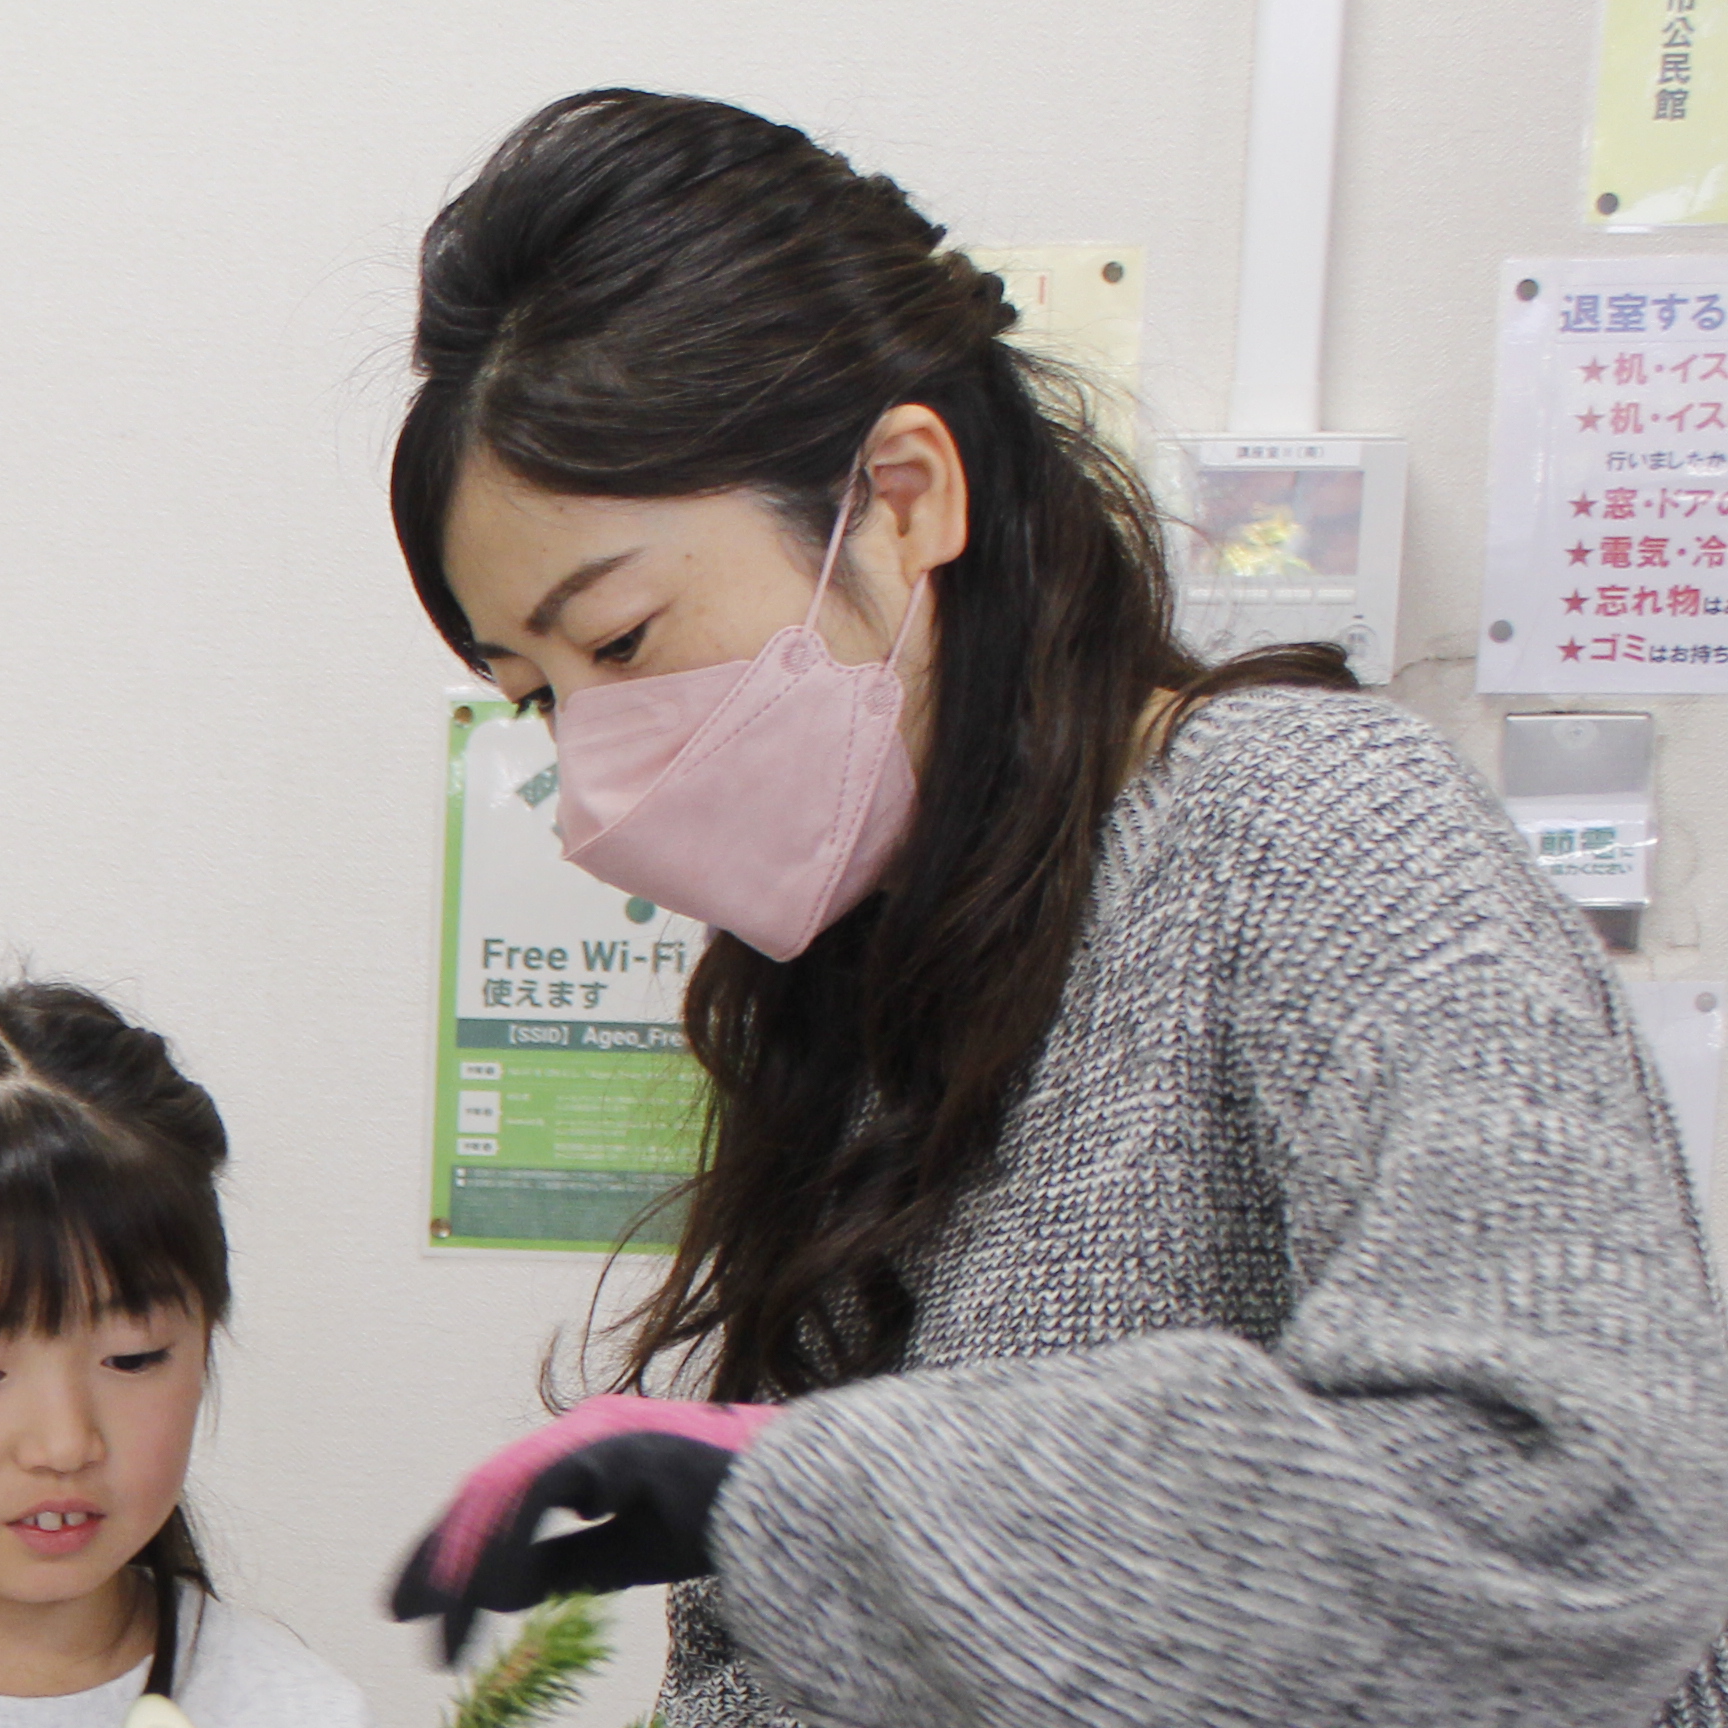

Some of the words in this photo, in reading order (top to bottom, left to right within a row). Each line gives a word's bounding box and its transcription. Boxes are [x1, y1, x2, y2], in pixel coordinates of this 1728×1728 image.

[1560, 293, 1726, 332] 退室する
[1595, 585, 1728, 617] 忘れ物は
[482, 938, 568, 971] Free
[582, 940, 686, 973] Wi-Fi
[483, 978, 608, 1010] 使えます
[581, 1027, 688, 1051] Ageo_Fre
